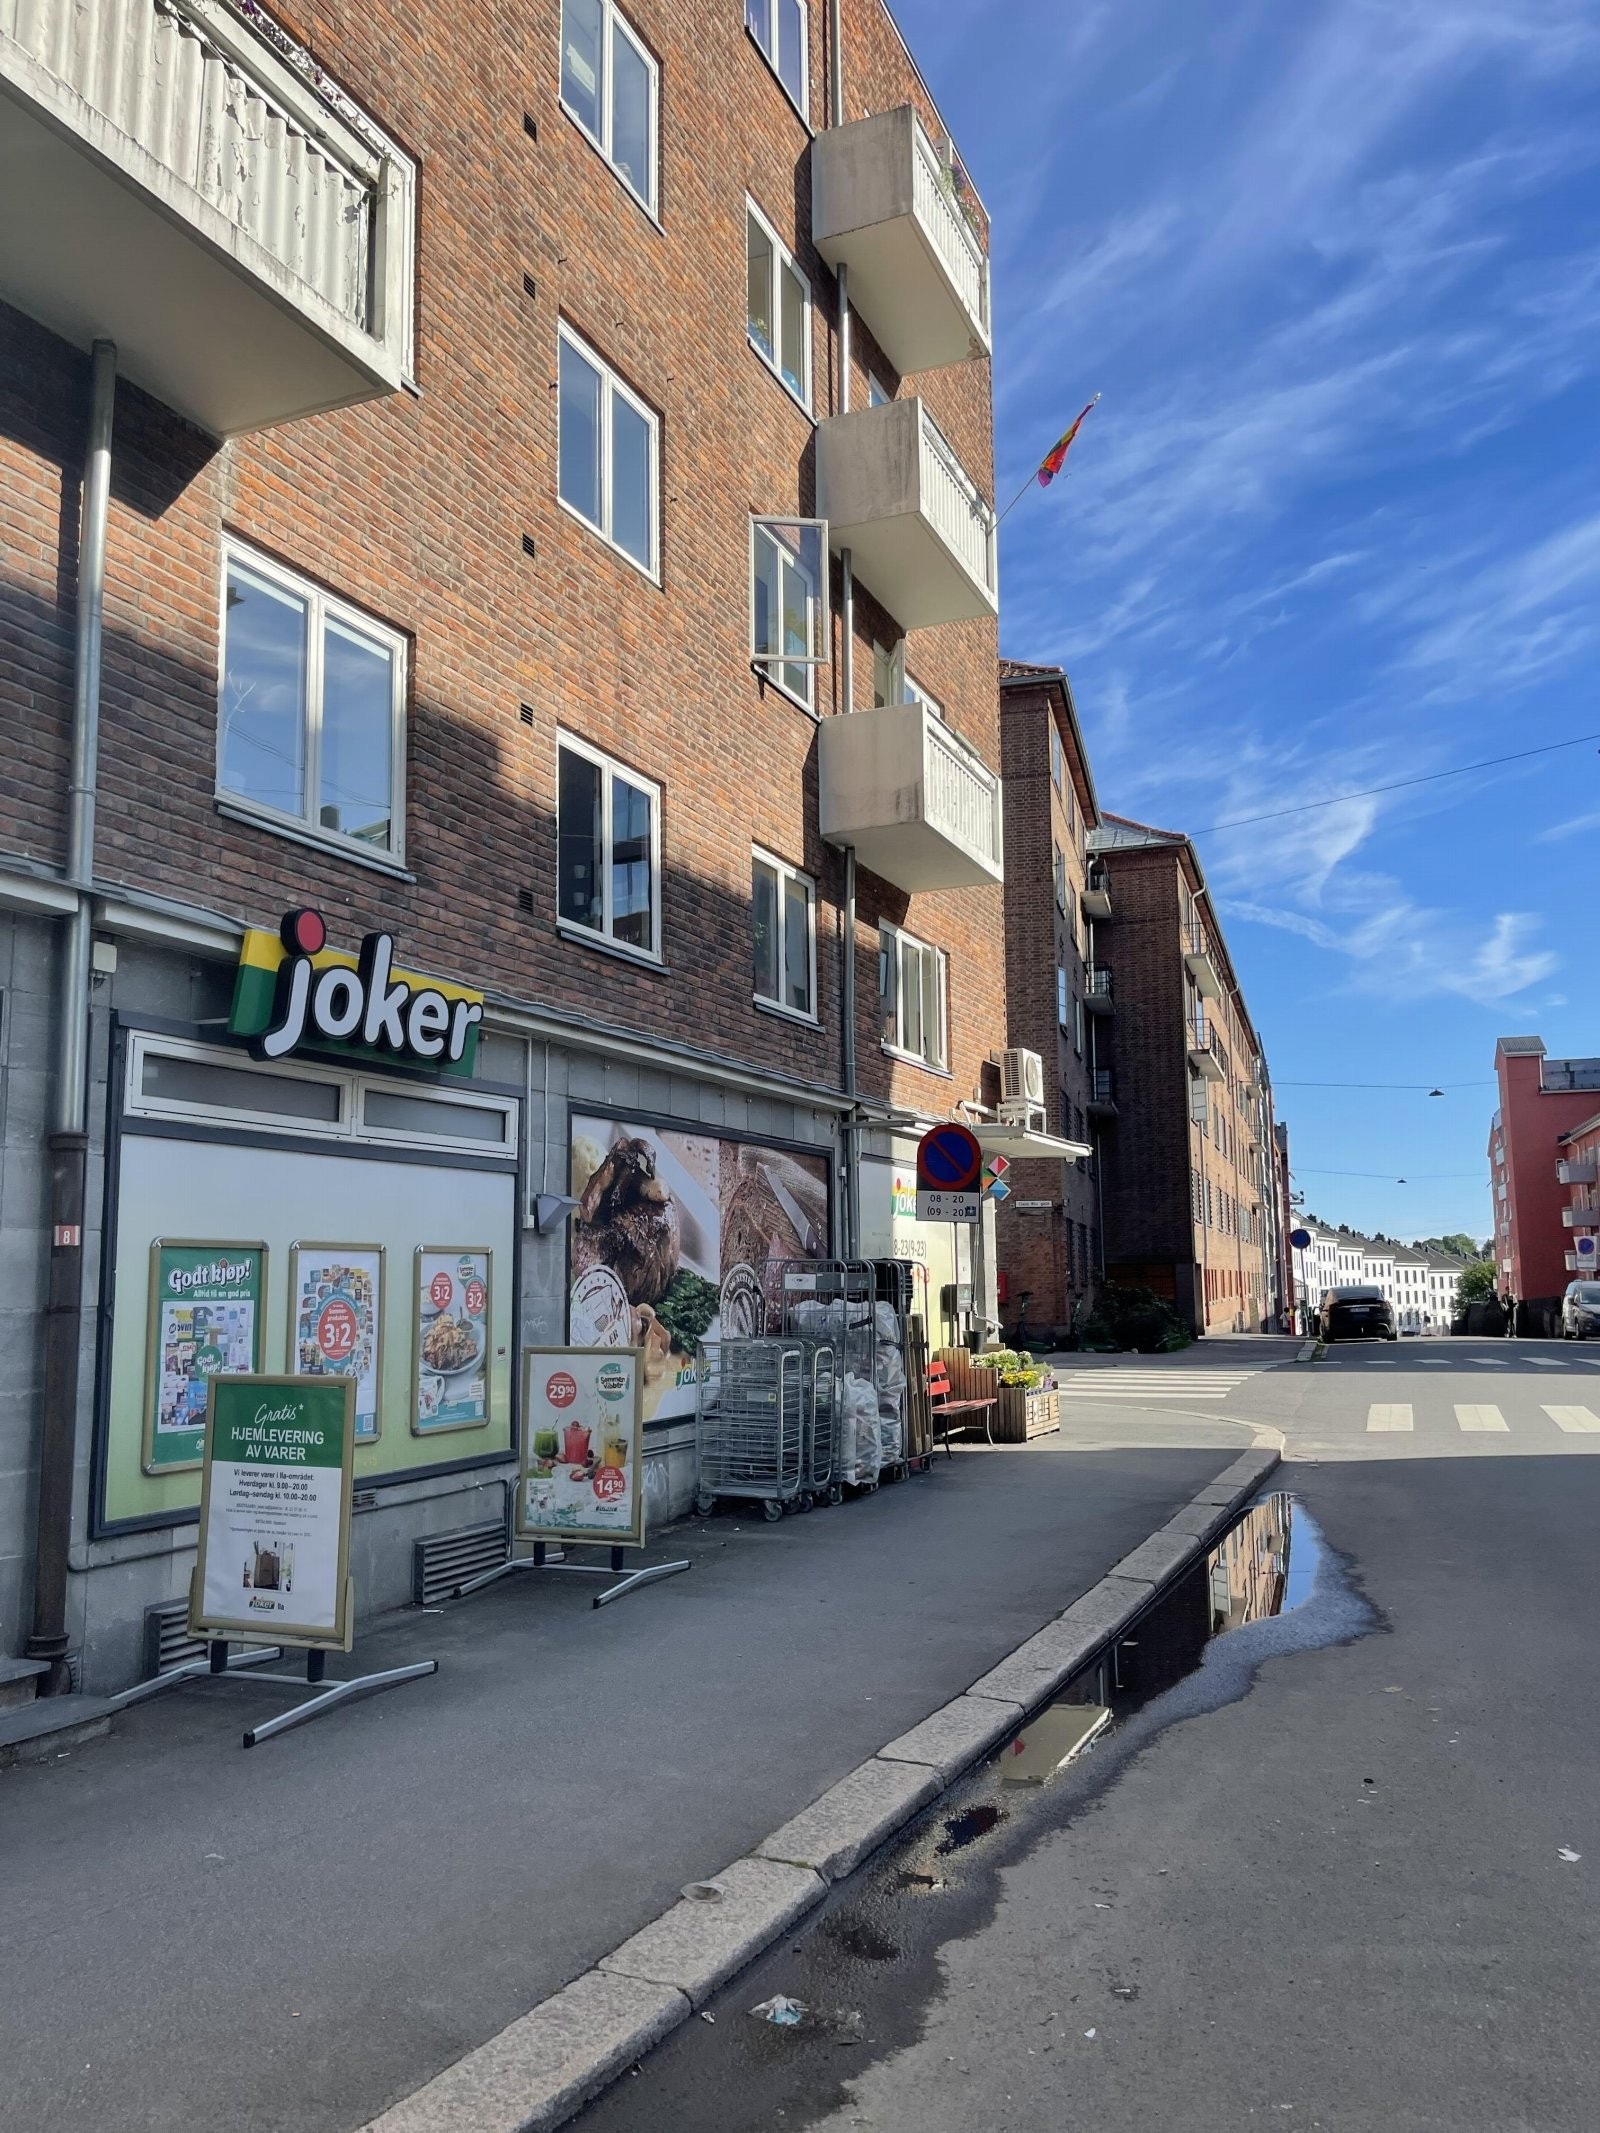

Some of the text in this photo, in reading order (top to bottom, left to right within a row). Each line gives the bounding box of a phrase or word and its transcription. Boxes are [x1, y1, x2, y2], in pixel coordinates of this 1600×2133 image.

[262, 908, 483, 1061] joker
[930, 1194, 941, 1203] 08
[952, 1195, 964, 1203] 20
[927, 1205, 941, 1216] (09
[63, 1230, 71, 1244] 8
[169, 1258, 252, 1294] Godt kjøp!
[193, 1289, 210, 1298] Alltid
[227, 1289, 240, 1299] god
[240, 1289, 251, 1299] pris
[434, 1286, 441, 1300] 3
[444, 1285, 450, 1300] 2
[467, 1292, 474, 1307] 3
[476, 1292, 483, 1307] 2
[324, 1323, 335, 1348] 3
[340, 1322, 351, 1347] 2
[677, 1356, 710, 1390] jokr
[231, 1427, 325, 1445] HJEMLEVERING
[245, 1444, 306, 1461] AV VARER
[234, 1468, 240, 1476] Vi
[241, 1470, 260, 1478] leverer
[238, 1479, 268, 1490] Hverdager
